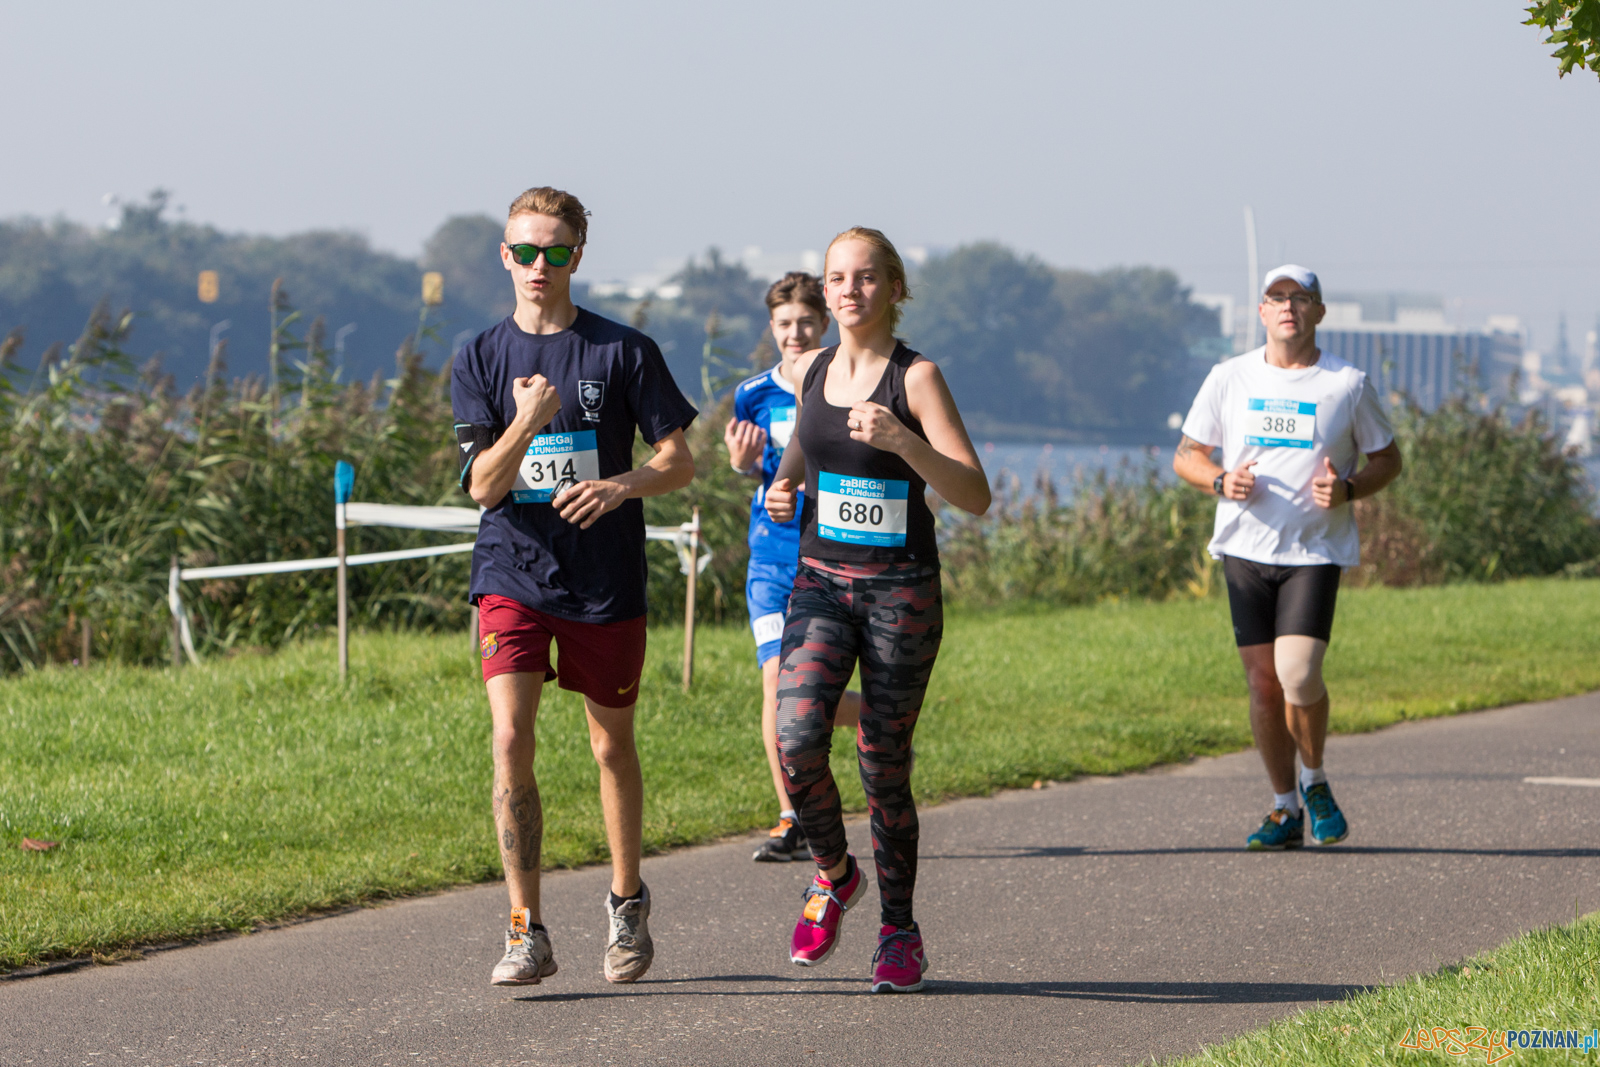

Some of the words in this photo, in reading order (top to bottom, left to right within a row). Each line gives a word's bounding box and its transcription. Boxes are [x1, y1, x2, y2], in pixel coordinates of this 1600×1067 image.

[1262, 416, 1296, 433] 388
[535, 446, 574, 455] FUNdusze
[530, 458, 577, 483] 314
[839, 478, 886, 492] zaBIEGaj
[846, 487, 885, 498] FUNdusze
[838, 501, 884, 526] 680
